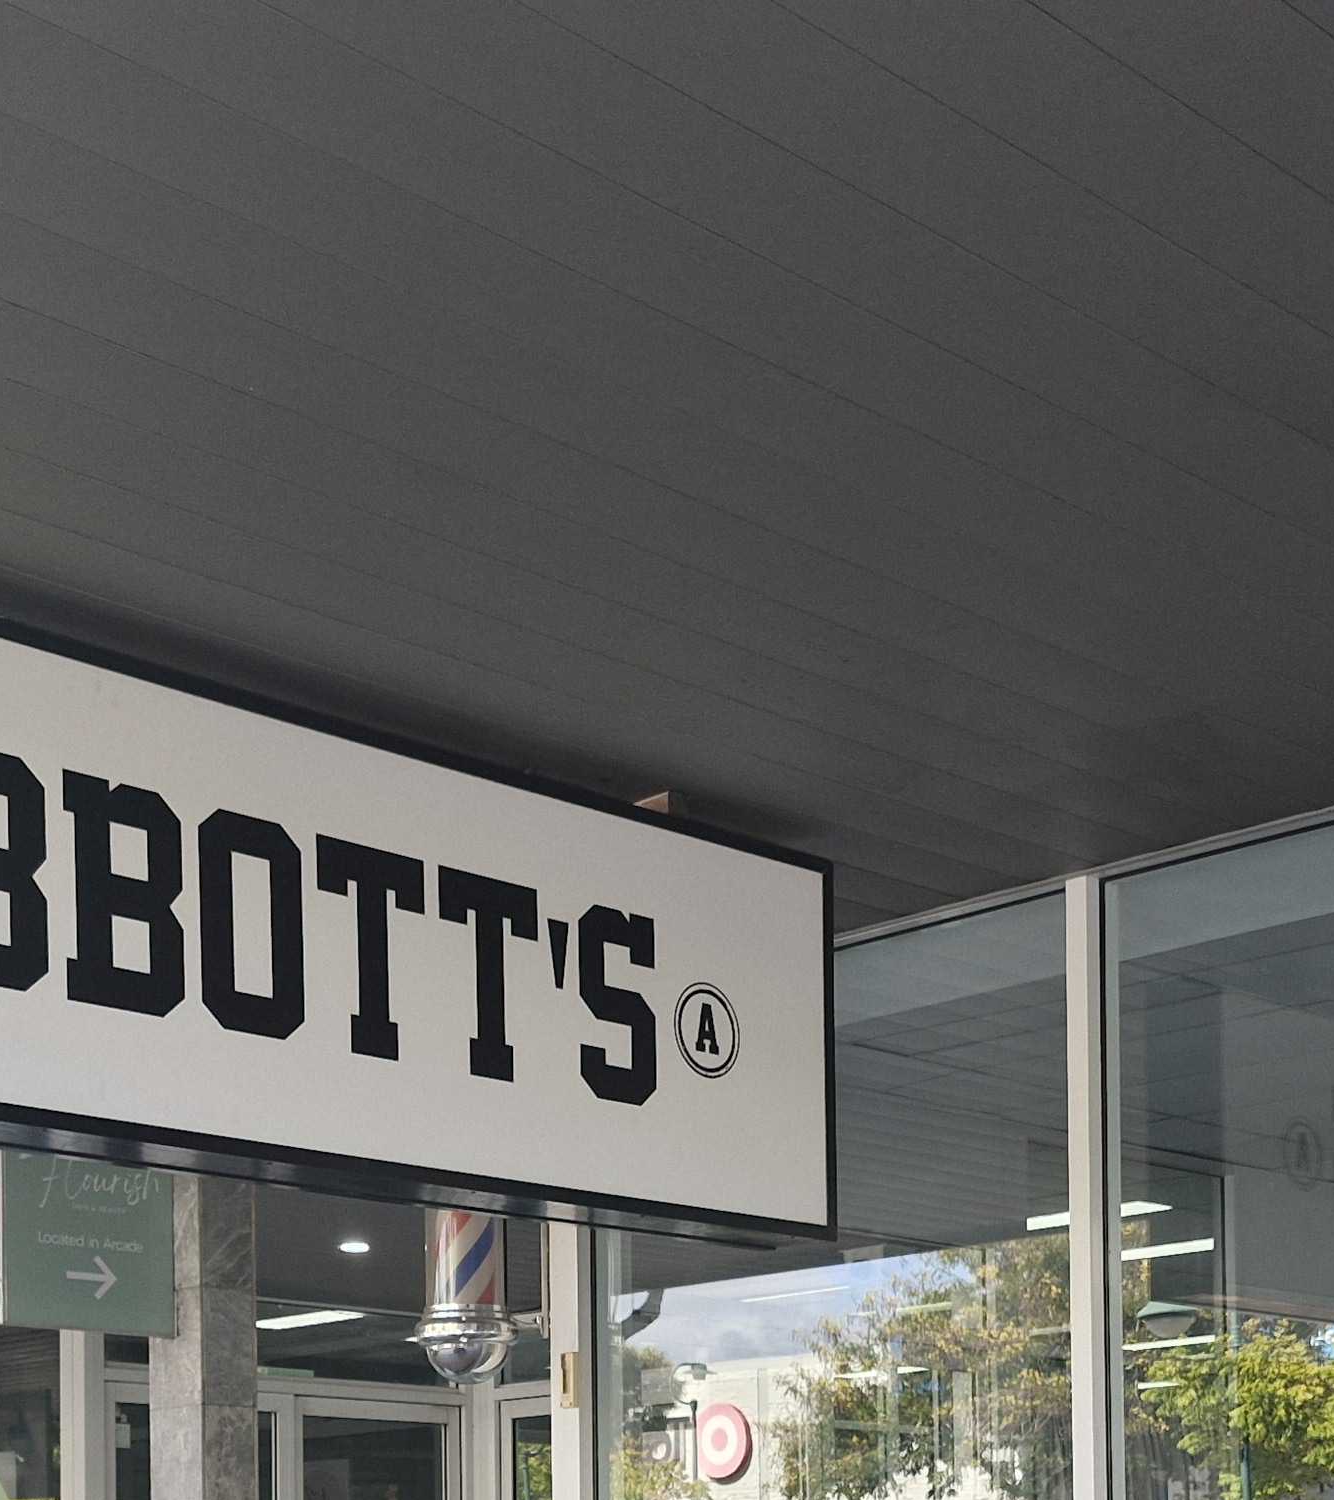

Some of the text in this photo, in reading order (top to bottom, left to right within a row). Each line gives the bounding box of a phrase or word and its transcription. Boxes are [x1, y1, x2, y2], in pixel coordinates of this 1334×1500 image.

[695, 1002, 720, 1057] A
[38, 1231, 144, 1253] Located in Arcade
